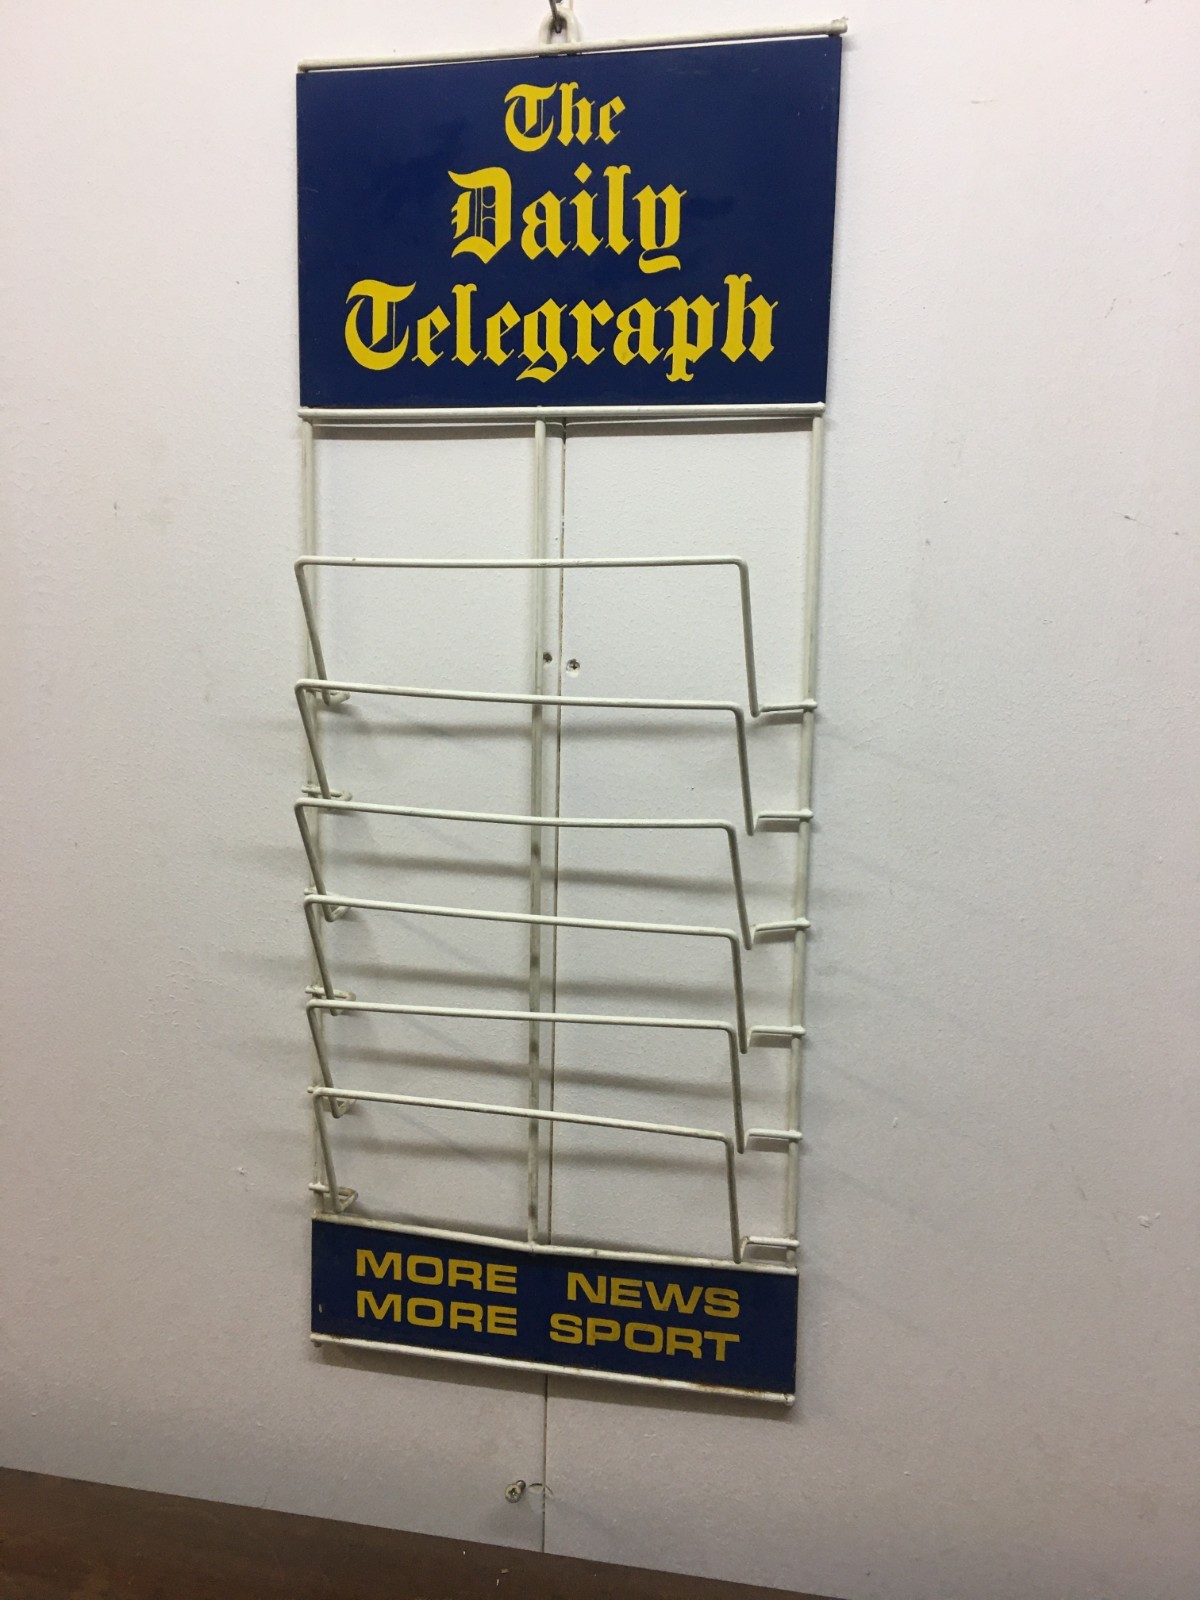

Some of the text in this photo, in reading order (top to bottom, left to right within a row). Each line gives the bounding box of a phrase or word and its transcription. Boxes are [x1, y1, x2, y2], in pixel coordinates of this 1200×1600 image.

[504, 82, 626, 152] The
[447, 162, 687, 274] Daily
[344, 273, 779, 384] Telegraph
[356, 1248, 740, 1319] MORE NEWS
[356, 1290, 740, 1361] MORE SPORT
